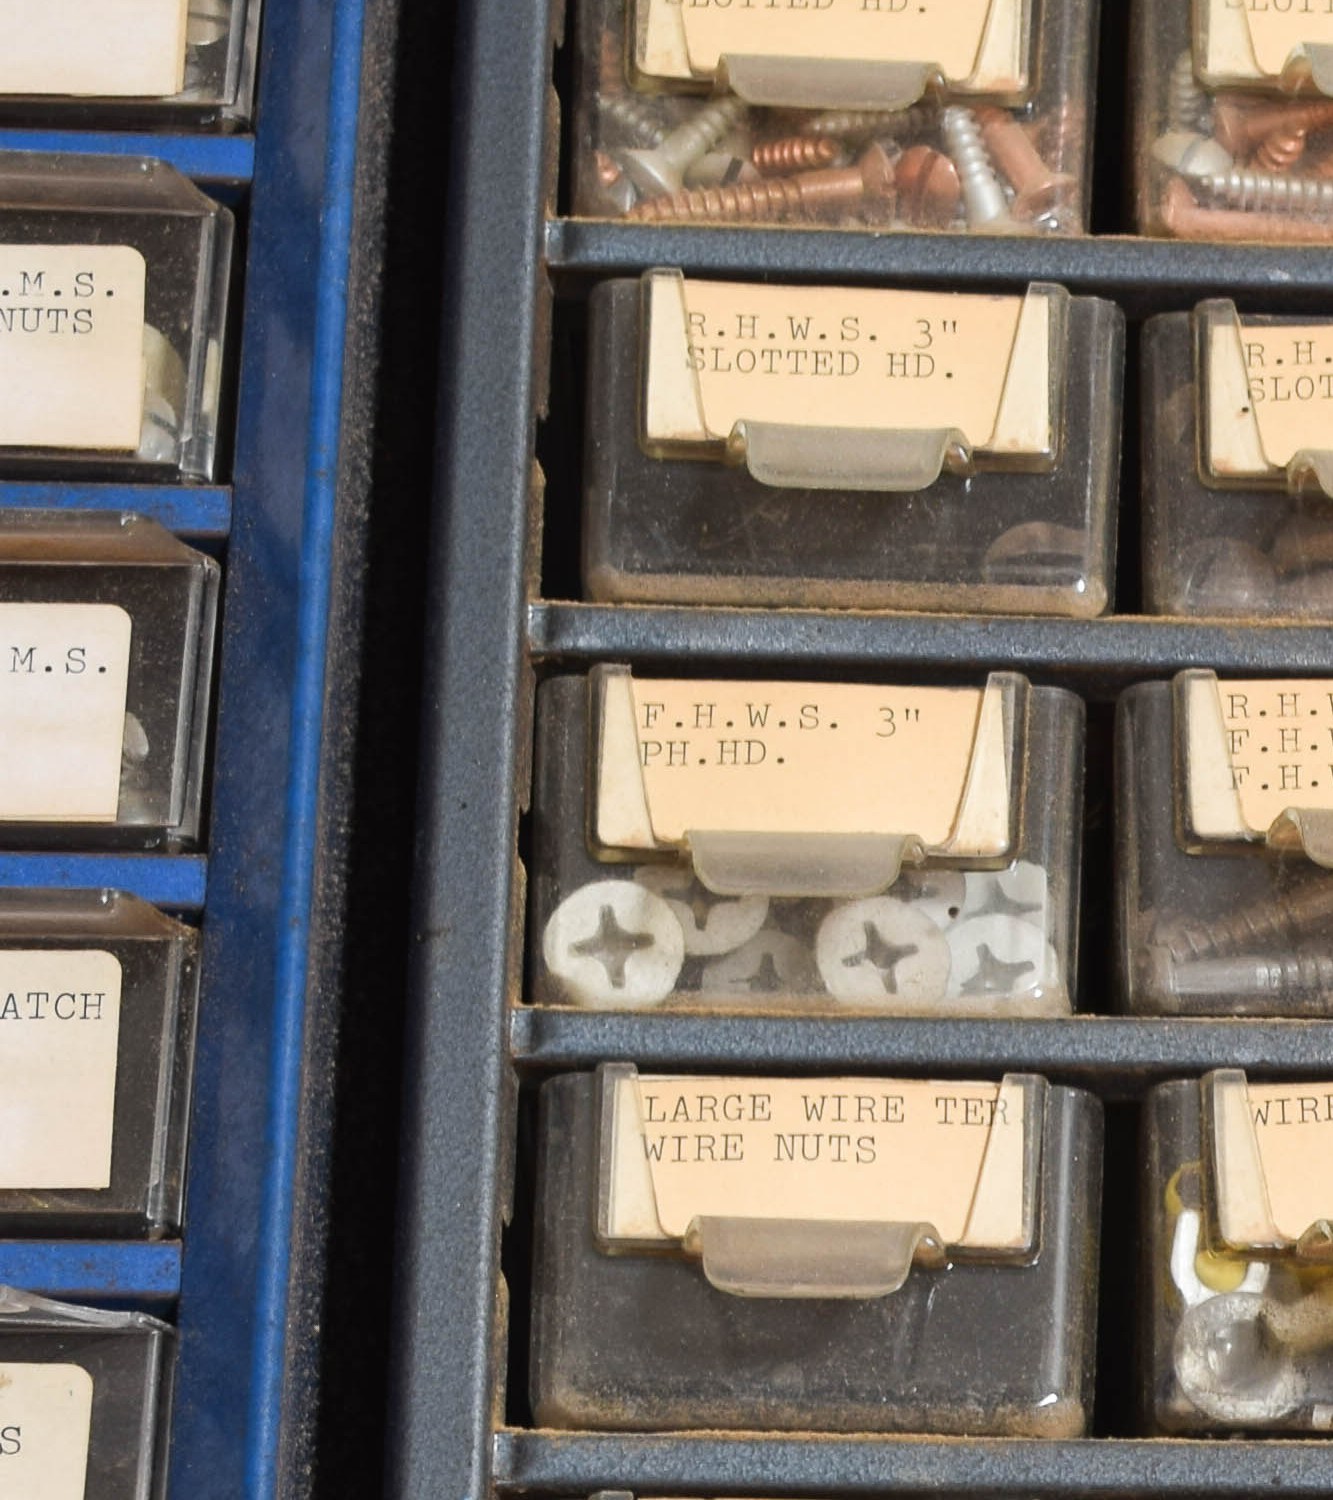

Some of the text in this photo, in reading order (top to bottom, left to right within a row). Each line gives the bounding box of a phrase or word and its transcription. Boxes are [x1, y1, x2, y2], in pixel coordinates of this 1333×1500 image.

[686, 311, 958, 351] R.H.W.S. 3"
[686, 345, 954, 379] SLOTTED HD.
[641, 702, 921, 738] F.H.W.S. 3"
[641, 739, 785, 767] PH.HD.
[644, 1094, 905, 1124] LARGE WIRE
[641, 1133, 877, 1164] WIRE NUTS
